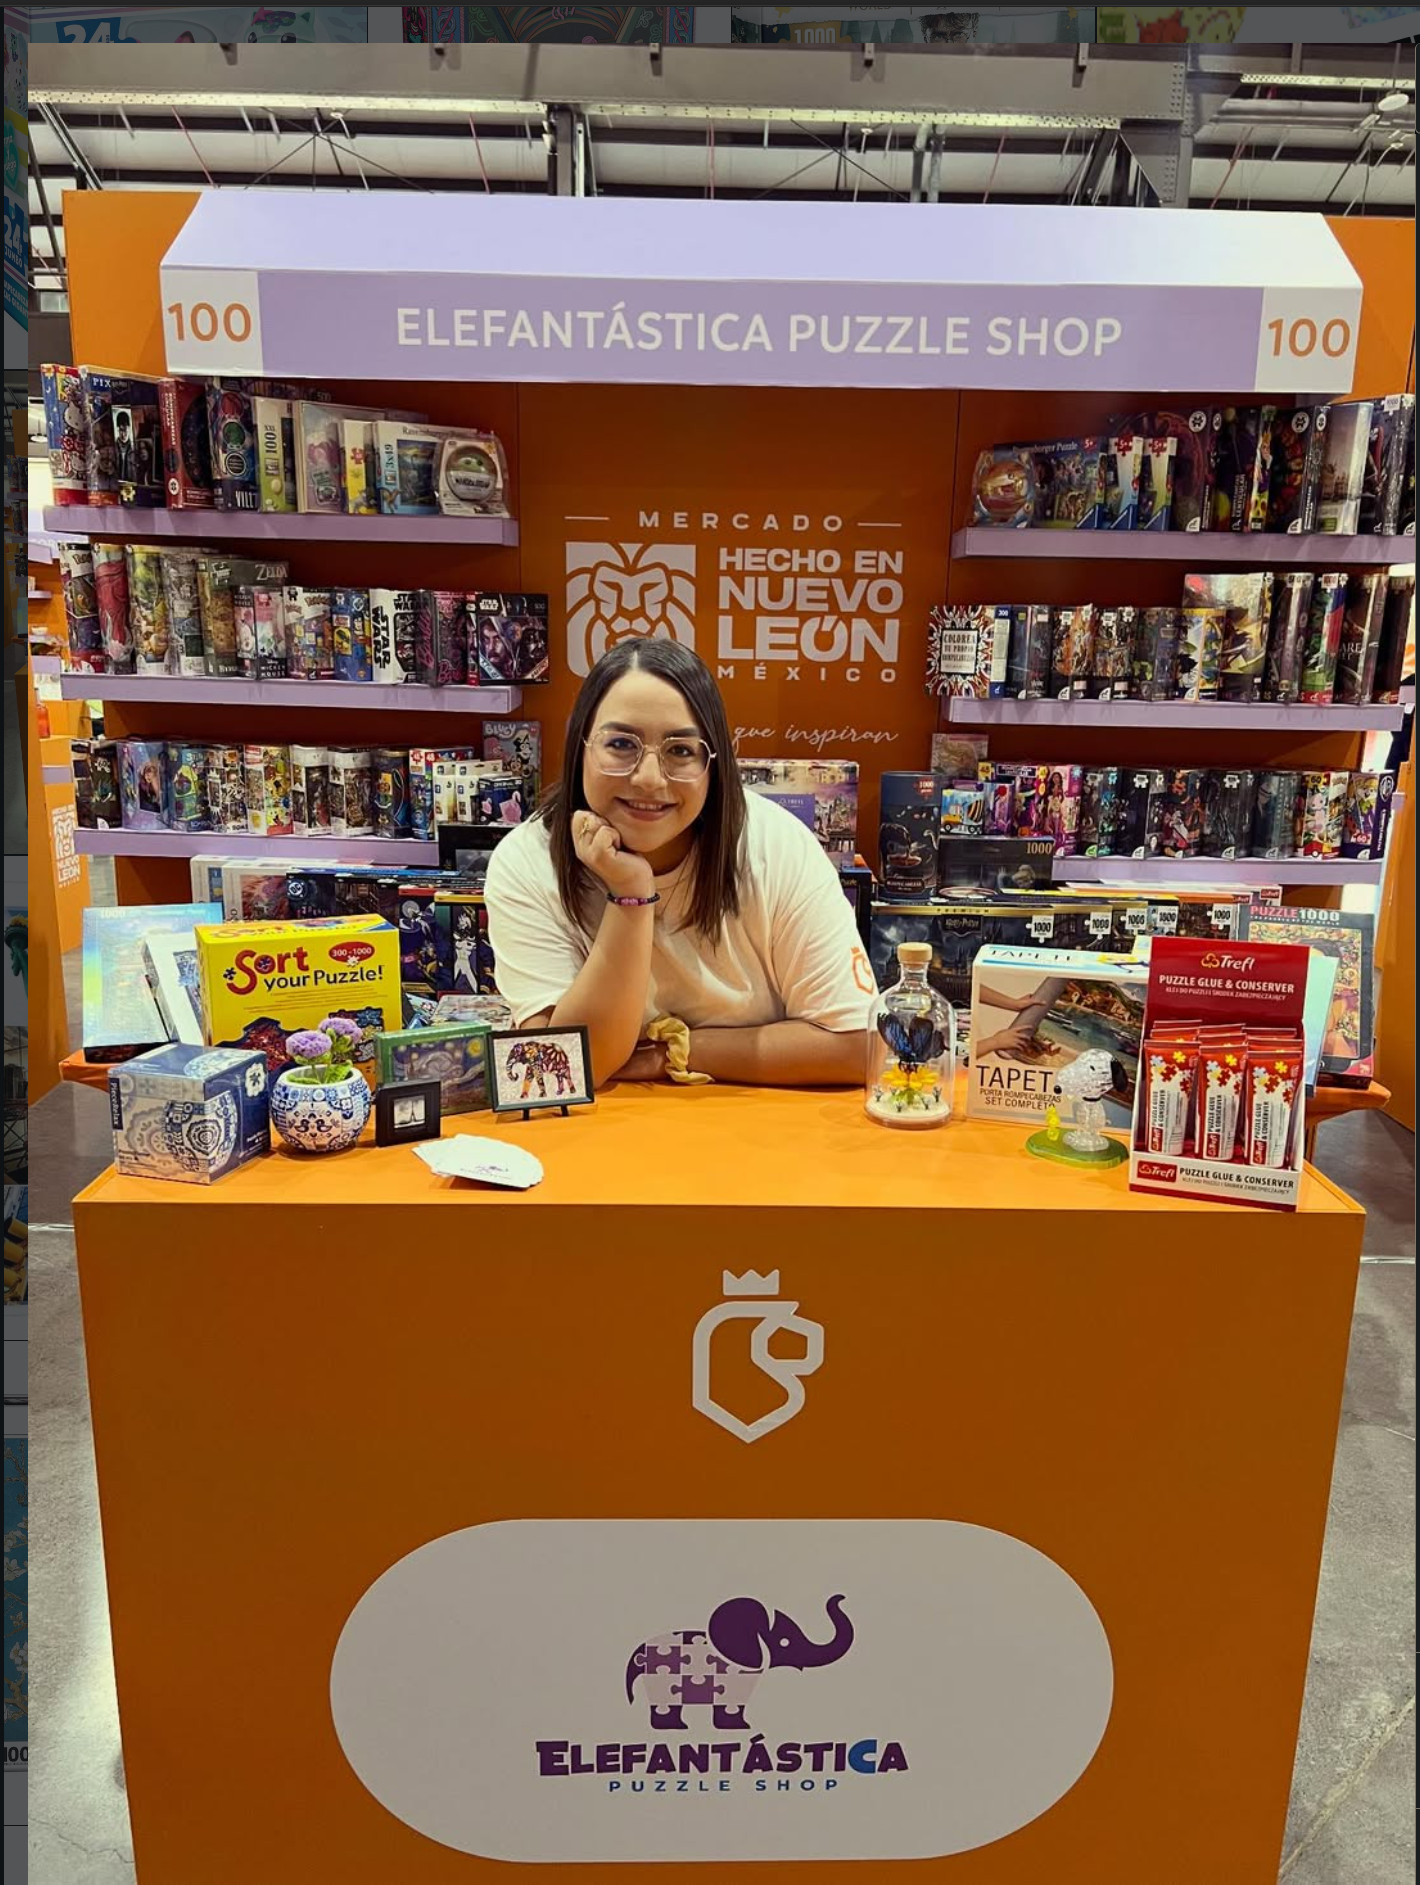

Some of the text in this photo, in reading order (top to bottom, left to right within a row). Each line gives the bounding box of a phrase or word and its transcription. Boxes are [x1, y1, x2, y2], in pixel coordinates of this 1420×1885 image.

[168, 301, 252, 342] 100
[397, 302, 1122, 356] ELEFANTÁSTICA PUZZLE SHOP
[1267, 317, 1351, 357] 100
[639, 511, 842, 531] MERCADO
[719, 547, 903, 574] HECHO EN
[718, 576, 903, 613] NUEVO
[718, 616, 899, 663] LEÓN
[718, 662, 896, 682] MÉXICO
[733, 723, 898, 752] que inspiran
[1027, 843, 1052, 855] 1000
[1214, 910, 1230, 921] 1000
[1250, 906, 1297, 918] PUZZLE
[1299, 908, 1340, 921] 1000
[1033, 922, 1050, 933] 1000
[353, 947, 372, 955] 1000
[226, 947, 309, 995] Sort
[1220, 955, 1255, 972] Trefl
[264, 965, 383, 992] your Puzzle!
[1159, 975, 1294, 993] PUZZLE GLUE & CONSERVER
[976, 1065, 1053, 1092] TAPET
[980, 1088, 1061, 1103] PORTA ROMPECABEZAS
[985, 1096, 1001, 1105] SET
[1152, 1166, 1175, 1178] Trefl
[1180, 1167, 1294, 1188] PUZZLE GLUE & CONSERVER
[536, 1733, 909, 1776] ELEFANTÁSTICA
[609, 1779, 839, 1792] PUZZLE SHOP
